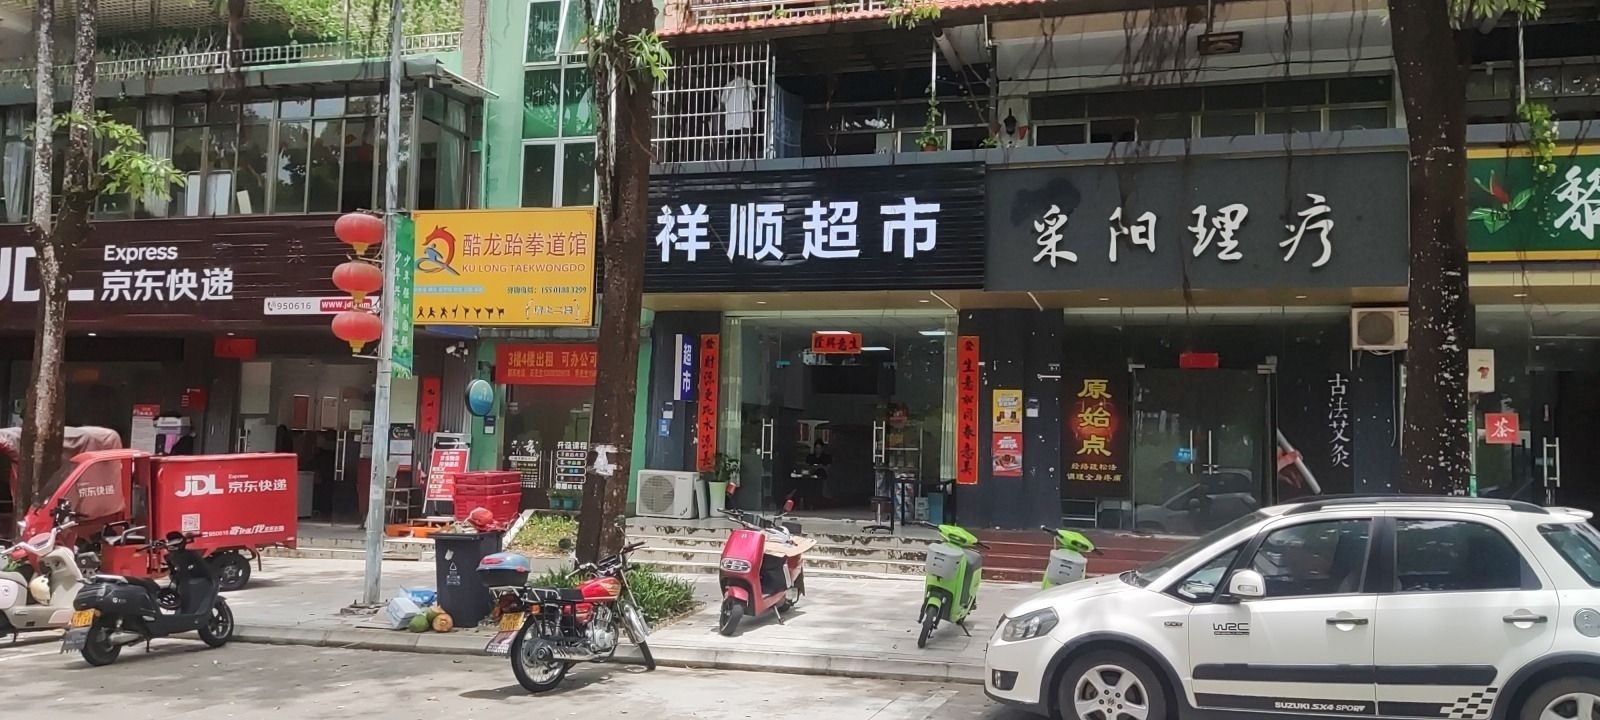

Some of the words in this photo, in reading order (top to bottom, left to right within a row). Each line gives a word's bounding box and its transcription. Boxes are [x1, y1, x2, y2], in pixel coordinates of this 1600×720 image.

[655, 197, 941, 263] 祥顺超市
[1033, 193, 1335, 268] 采阳理疗
[103, 245, 178, 264] Express
[463, 232, 588, 257] 酷龙跆拳道馆
[462, 263, 476, 273] KU
[479, 263, 507, 273] LONG
[510, 263, 586, 273] TAEKWONGDO
[101, 268, 234, 302] 京东快递
[277, 302, 312, 310] 950616
[508, 351, 553, 367] 3楼4楼出租
[682, 344, 692, 392] 超市
[1077, 379, 1112, 456] 原始点
[1327, 373, 1350, 468] 古法艾灸
[1491, 417, 1515, 438] 茶
[175, 474, 224, 497] JDL
[228, 479, 288, 494] 京东快递
[1212, 622, 1250, 631] WRC
[1274, 701, 1310, 710] SUZUKI
[1311, 703, 1334, 711] SX4
[1335, 704, 1366, 712] SPORT
